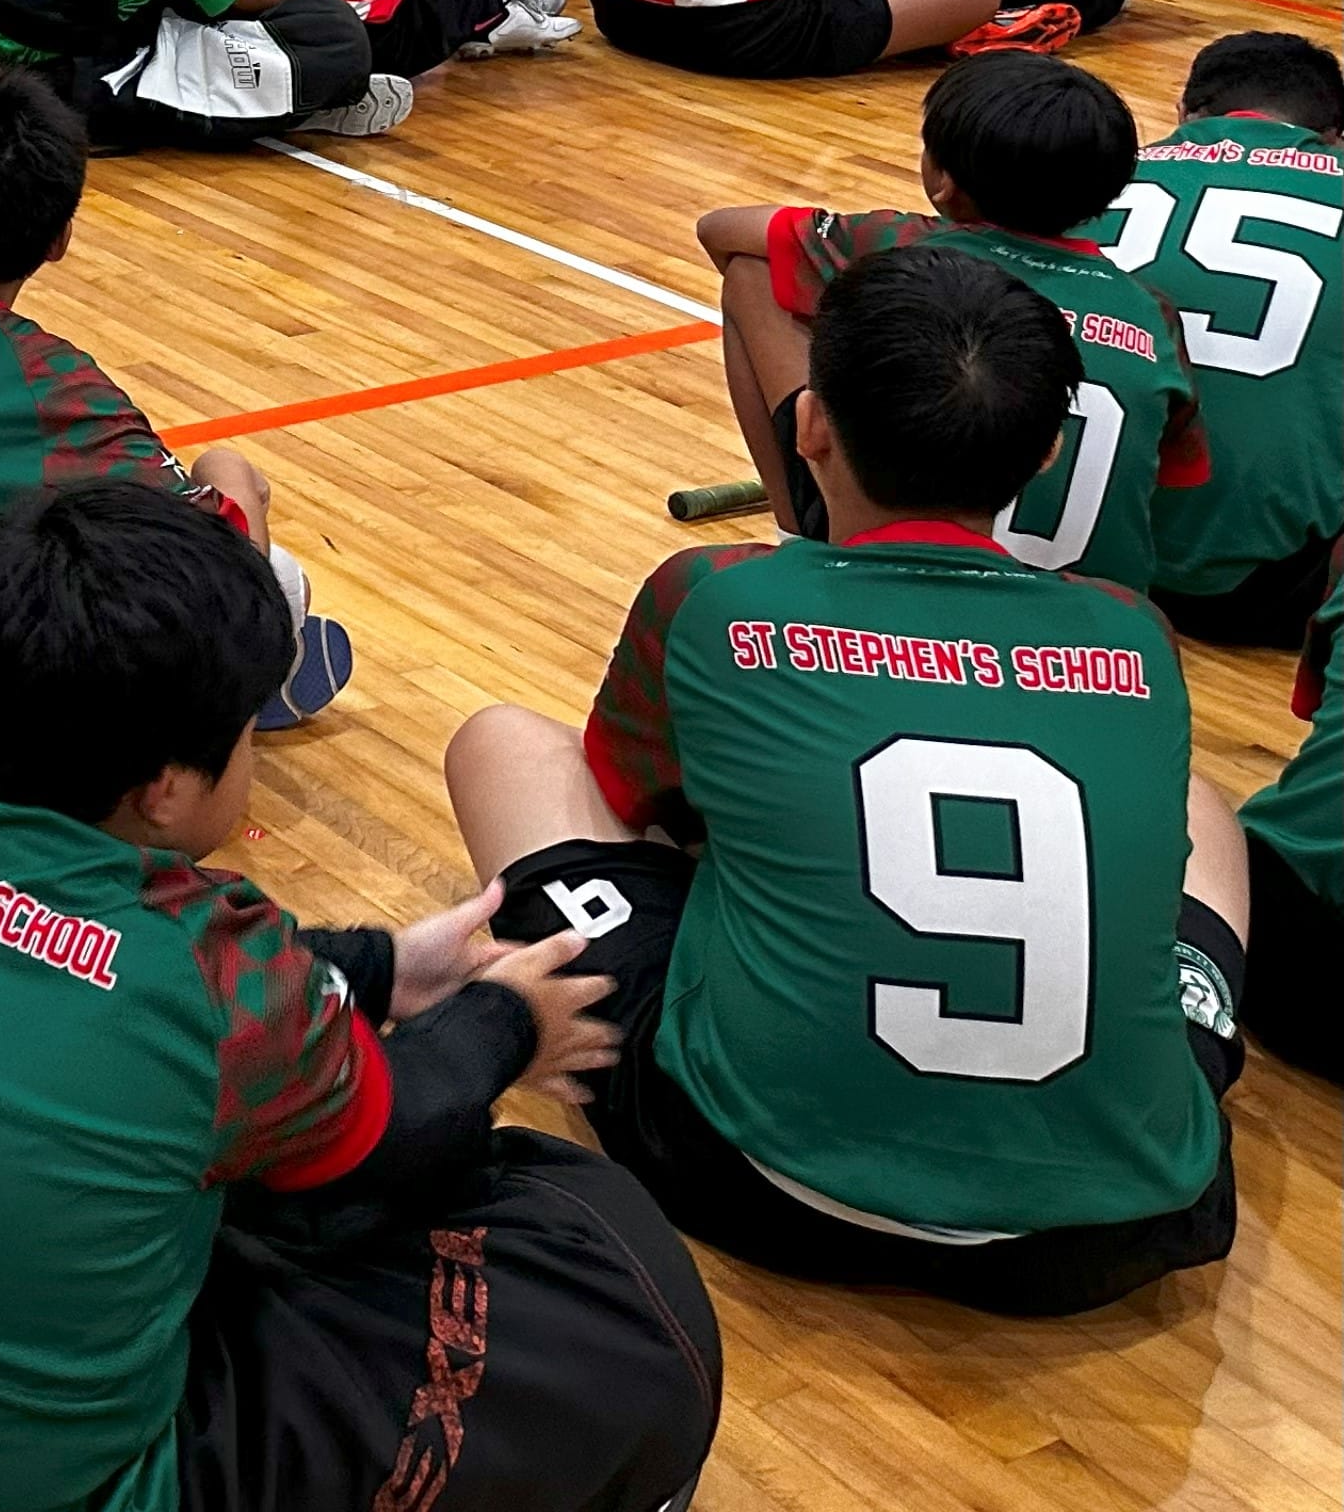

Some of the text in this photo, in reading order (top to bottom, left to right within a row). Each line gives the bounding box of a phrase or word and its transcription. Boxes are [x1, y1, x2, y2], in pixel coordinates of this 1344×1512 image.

[1247, 147, 1344, 176] SCHOOL
[1081, 312, 1157, 363] SCHOOL
[728, 620, 1151, 700] ST STEPHEN'S SCHOOL
[852, 733, 1092, 1083] 9
